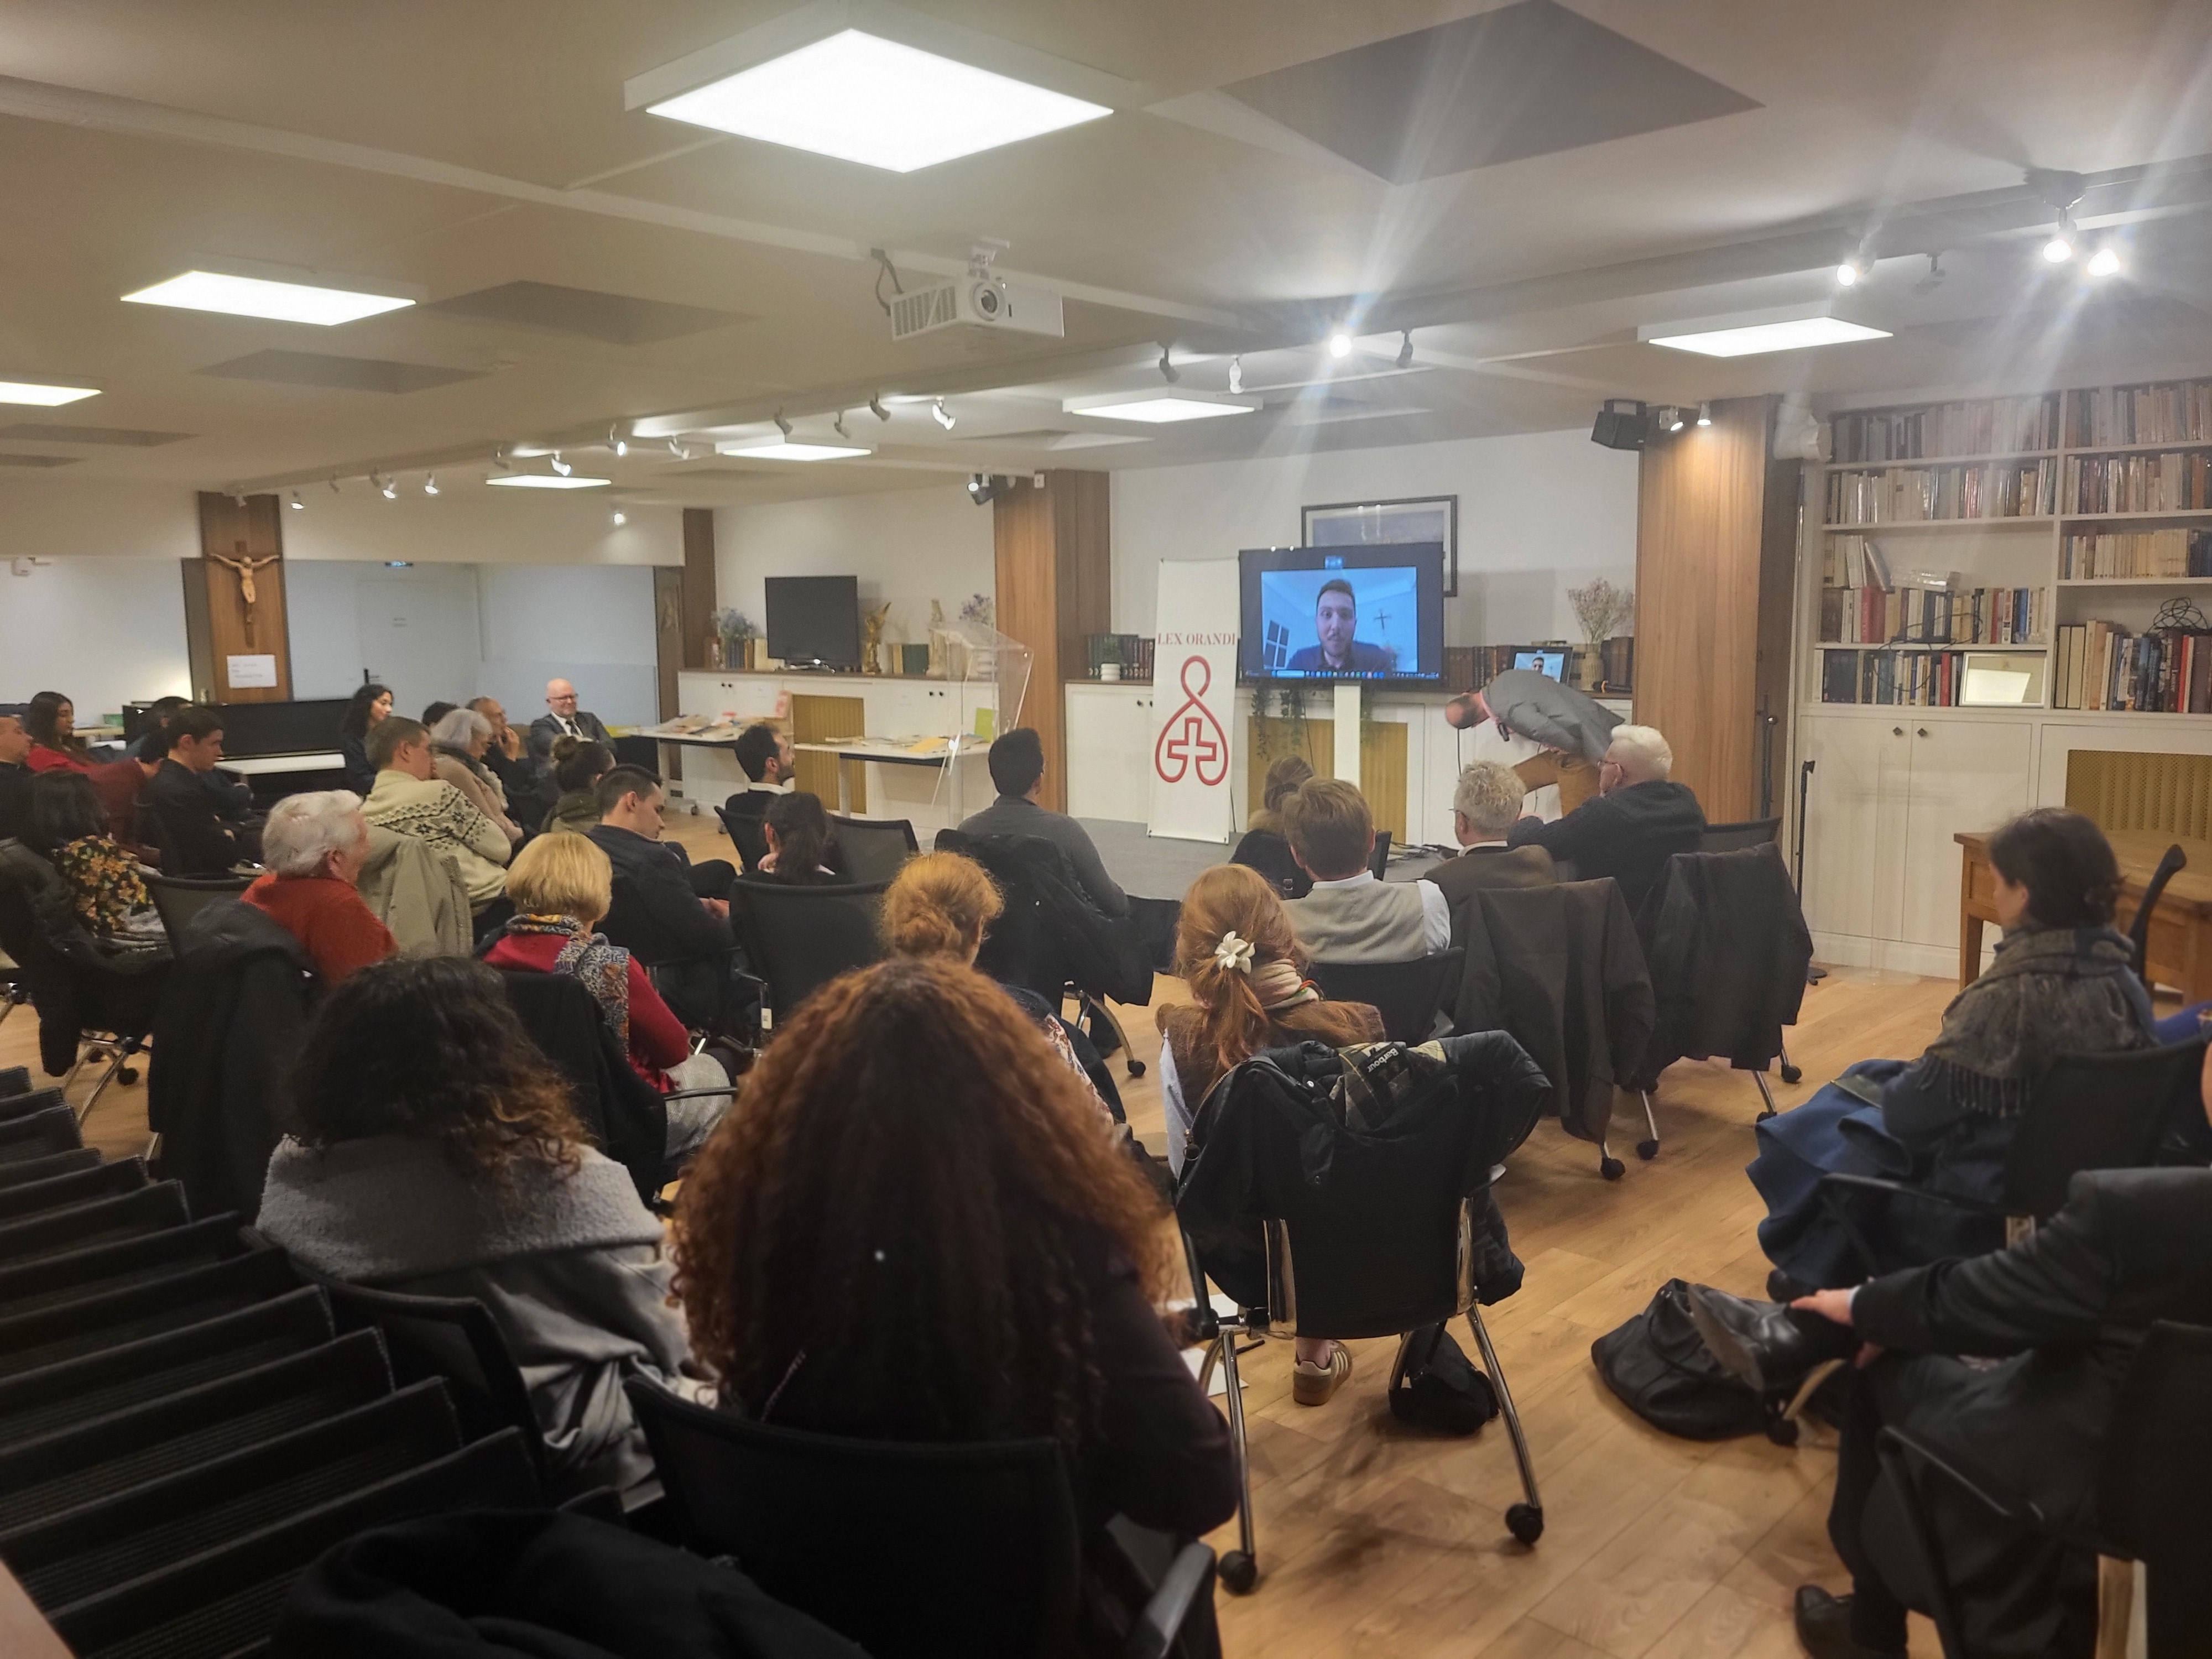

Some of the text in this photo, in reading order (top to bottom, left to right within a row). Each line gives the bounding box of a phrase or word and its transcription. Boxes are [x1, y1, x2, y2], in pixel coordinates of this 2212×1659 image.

[1158, 633, 1235, 645] LEX ORANDI
[1367, 1048, 1399, 1072] Barbour
